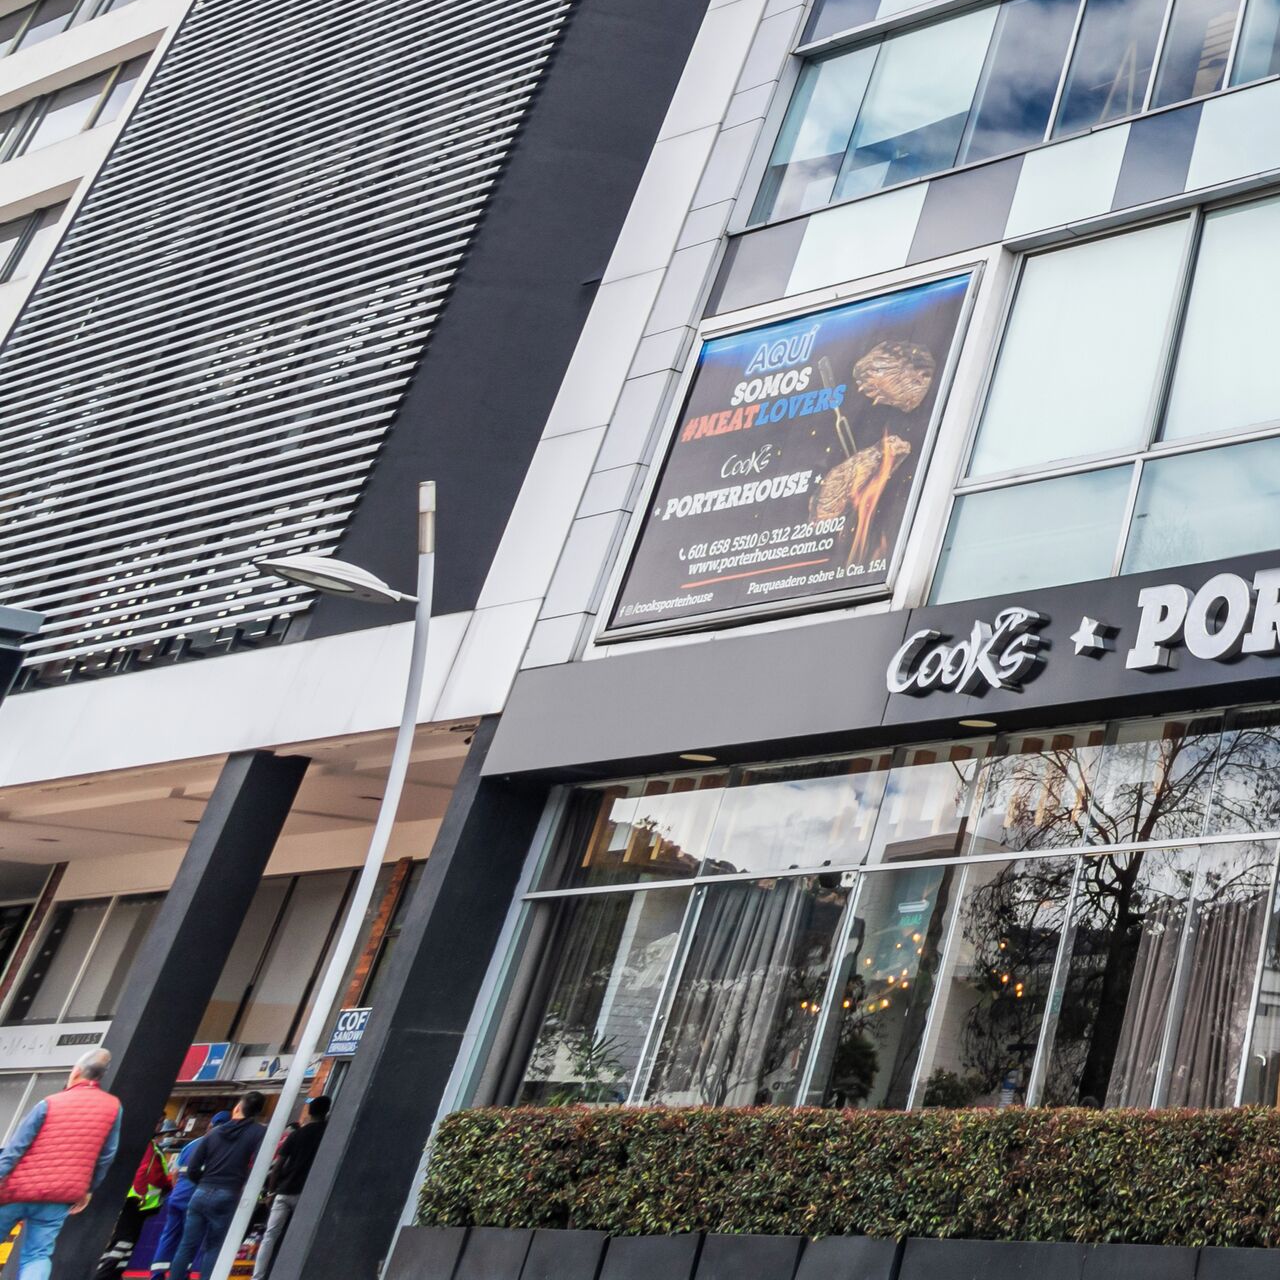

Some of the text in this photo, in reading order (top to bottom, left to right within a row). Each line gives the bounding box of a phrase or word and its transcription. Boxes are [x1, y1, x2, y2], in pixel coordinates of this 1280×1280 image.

[745, 324, 820, 375] AQUÍ
[731, 367, 812, 406] SOMOS
[681, 384, 848, 443] #MEATLOVERS
[662, 470, 812, 520] PORTERHOUSE
[687, 516, 846, 560] 601 658 5510 312 226 0802
[688, 538, 834, 575] www.porterhouse.com.co
[747, 558, 887, 594] Parqueadero sobre la Cra. 15A
[338, 1011, 370, 1031] COF
